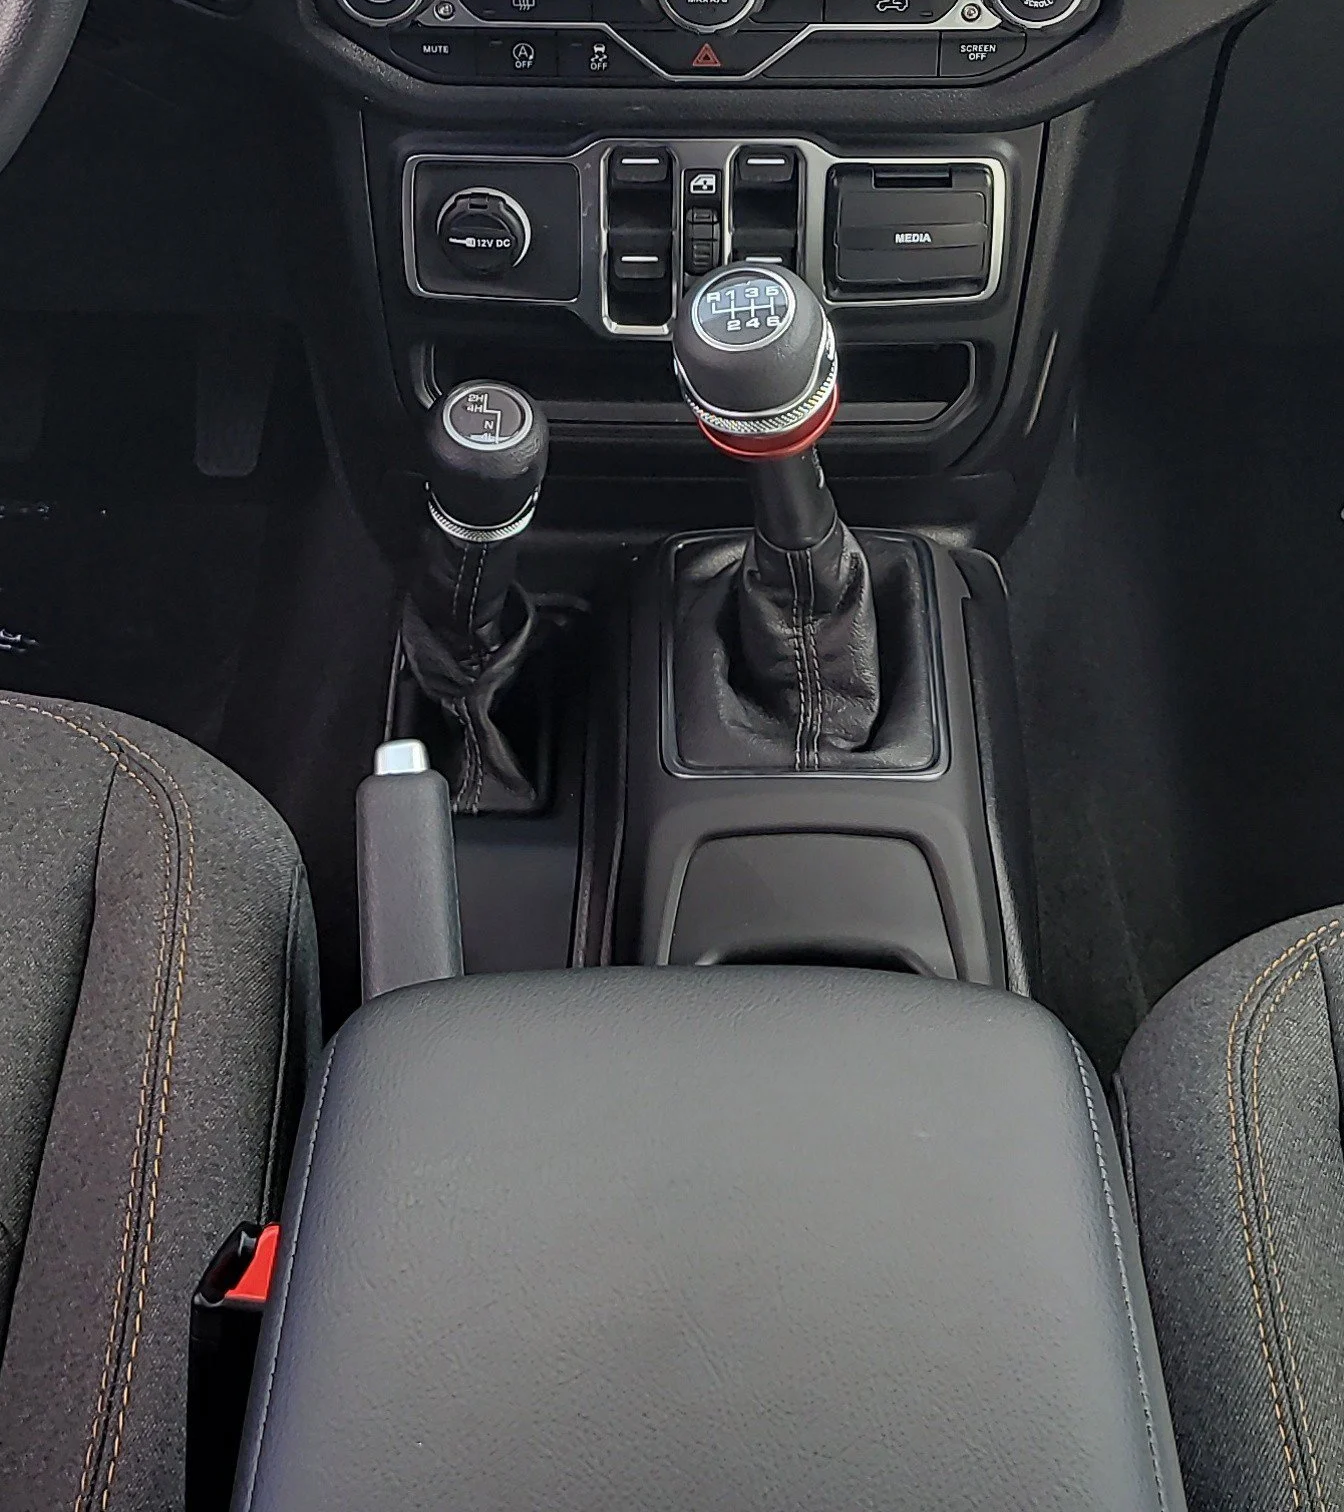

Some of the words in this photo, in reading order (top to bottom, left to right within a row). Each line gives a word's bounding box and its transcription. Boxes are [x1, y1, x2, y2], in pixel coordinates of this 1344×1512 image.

[422, 45, 450, 54] MUTE
[960, 44, 996, 53] SCREEN
[968, 52, 987, 61] OFF
[515, 60, 533, 70] OFF
[590, 62, 608, 71] OFF
[895, 232, 932, 244] MEDIA
[477, 239, 494, 248] 12V
[496, 239, 511, 248] DC
[706, 291, 721, 303] R
[744, 287, 759, 298] 3
[726, 319, 742, 331] 2
[745, 317, 761, 328] 4
[766, 315, 781, 327] 6
[466, 404, 483, 412] 4H
[484, 420, 494, 429] N
